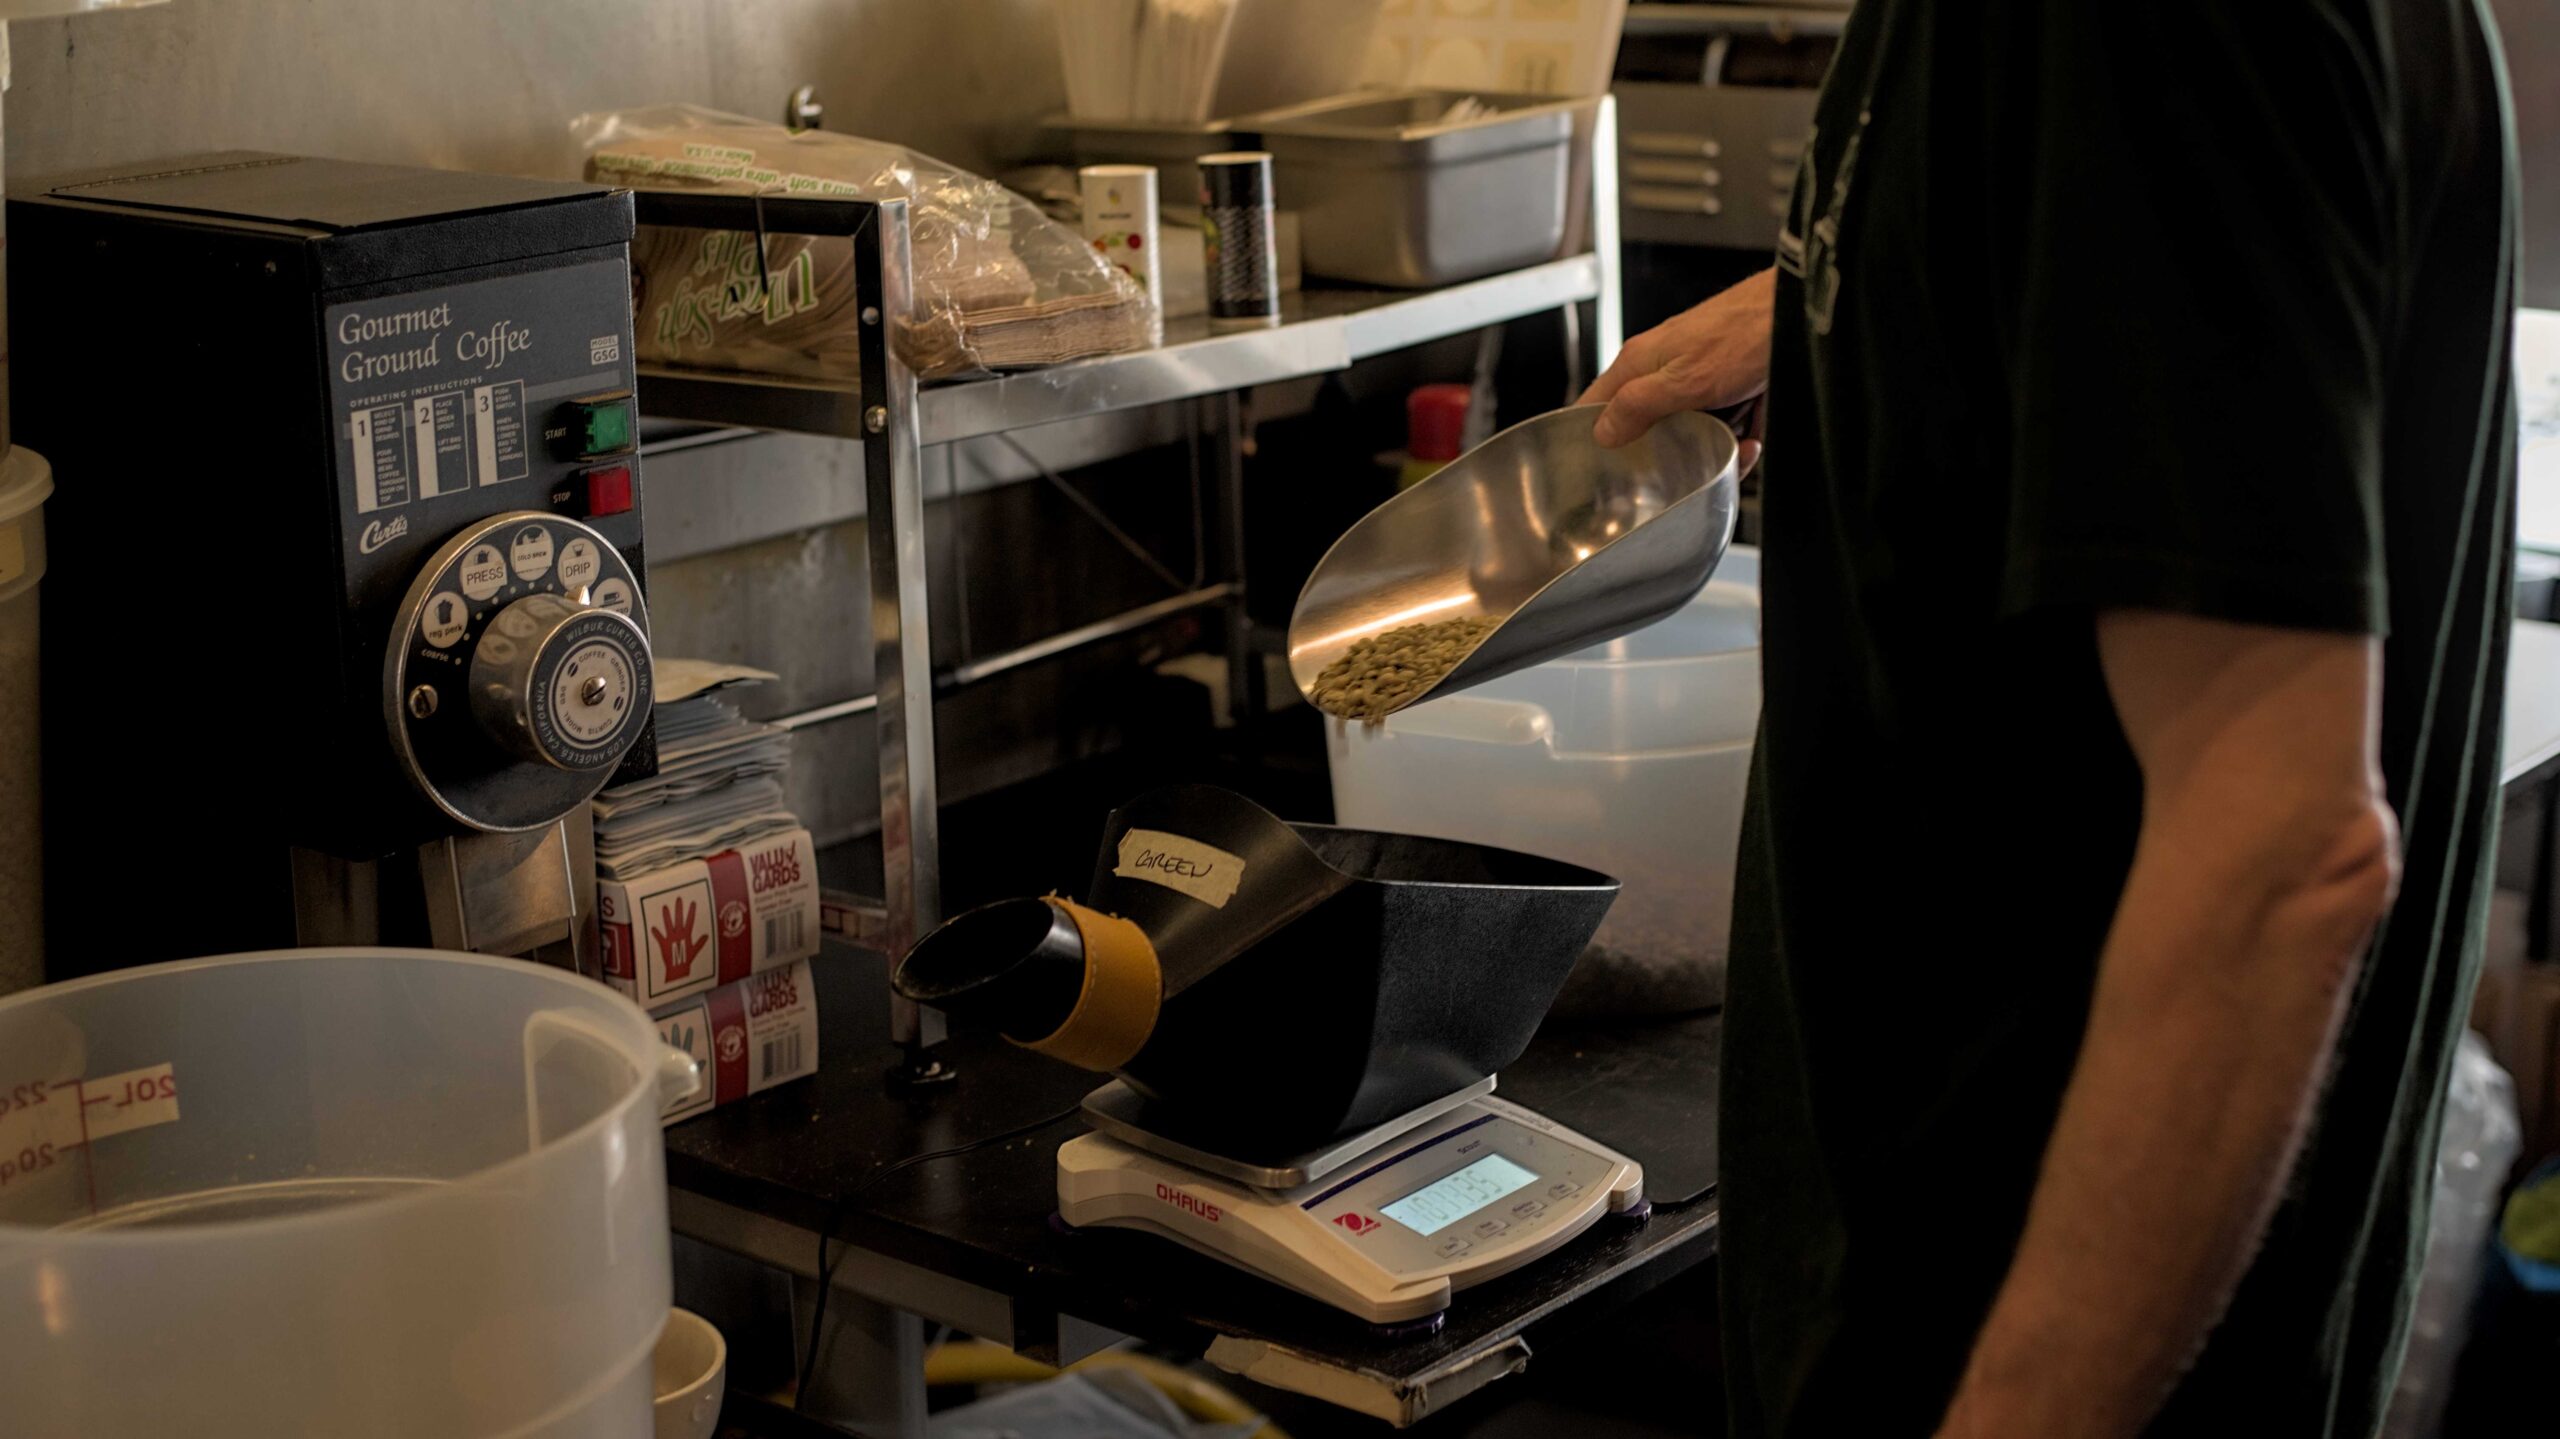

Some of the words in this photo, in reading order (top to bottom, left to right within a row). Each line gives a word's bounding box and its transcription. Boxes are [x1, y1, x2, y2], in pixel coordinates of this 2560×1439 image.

[662, 161, 743, 179] performance
[745, 170, 777, 181] ultra
[788, 174, 818, 189] soft
[339, 303, 453, 345] Gourmet
[592, 335, 617, 347] MODEL
[342, 333, 441, 383] Ground
[456, 320, 532, 369] Coffee
[593, 349, 617, 362] GSG
[350, 390, 408, 408] OPERATING
[411, 376, 483, 396] INSTRUCTIONS
[480, 396, 489, 413] 3
[420, 407, 430, 424] 2
[358, 420, 366, 437] 1
[544, 427, 567, 440] START
[553, 491, 571, 504] STOP
[360, 514, 408, 554] Curtis
[466, 566, 504, 585] PRESS
[565, 562, 591, 578] DRIP
[566, 621, 601, 643] WILBUR
[606, 622, 637, 650] CURTIS
[421, 648, 449, 661] coarse
[578, 650, 606, 663] COFFEE
[610, 657, 626, 693] GRINDER
[535, 681, 560, 749] CALIFORNIA
[562, 712, 583, 734] MODEL
[588, 718, 613, 735] CURTIS
[607, 736, 626, 754] LOS
[749, 847, 784, 875] VALU
[1135, 849, 1214, 878] GREEN
[753, 861, 801, 894] GARDS
[671, 940, 687, 967] M
[751, 985, 798, 1018] GARDS
[1156, 1183, 1219, 1222] OHAUS
